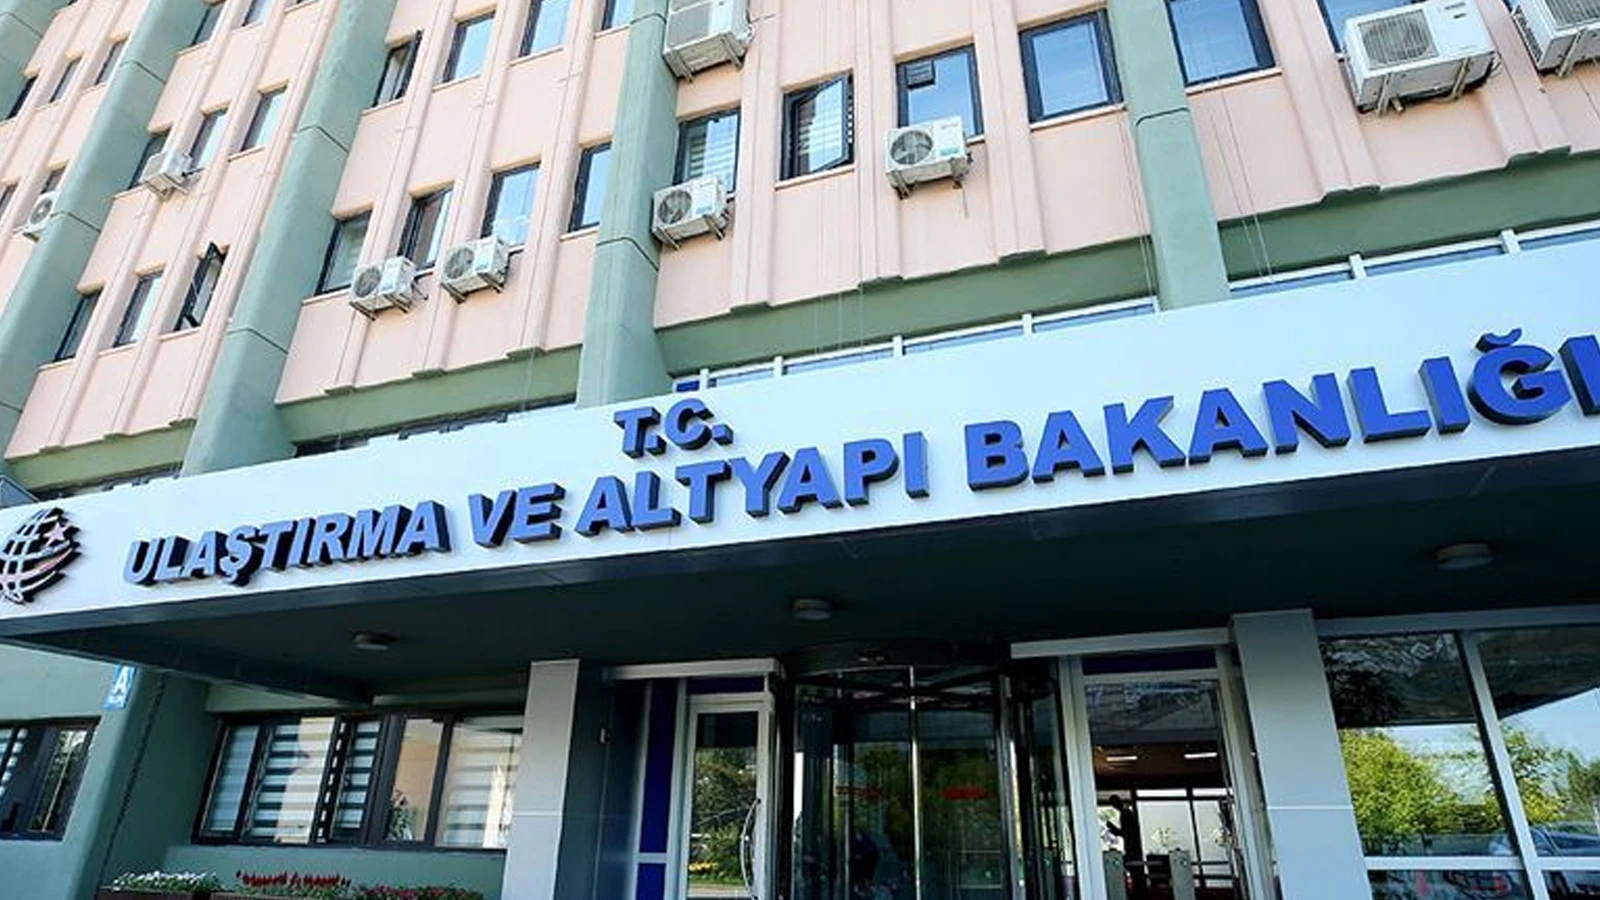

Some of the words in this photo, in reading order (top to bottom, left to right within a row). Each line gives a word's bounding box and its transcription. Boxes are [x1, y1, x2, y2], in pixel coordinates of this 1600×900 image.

[123, 500, 451, 587] ULAŞTIRMA
[468, 483, 567, 548] VE
[574, 431, 930, 536] ALTYAPI
[964, 328, 1600, 492] BAKANLIĞI
[614, 398, 734, 459] T.C.
